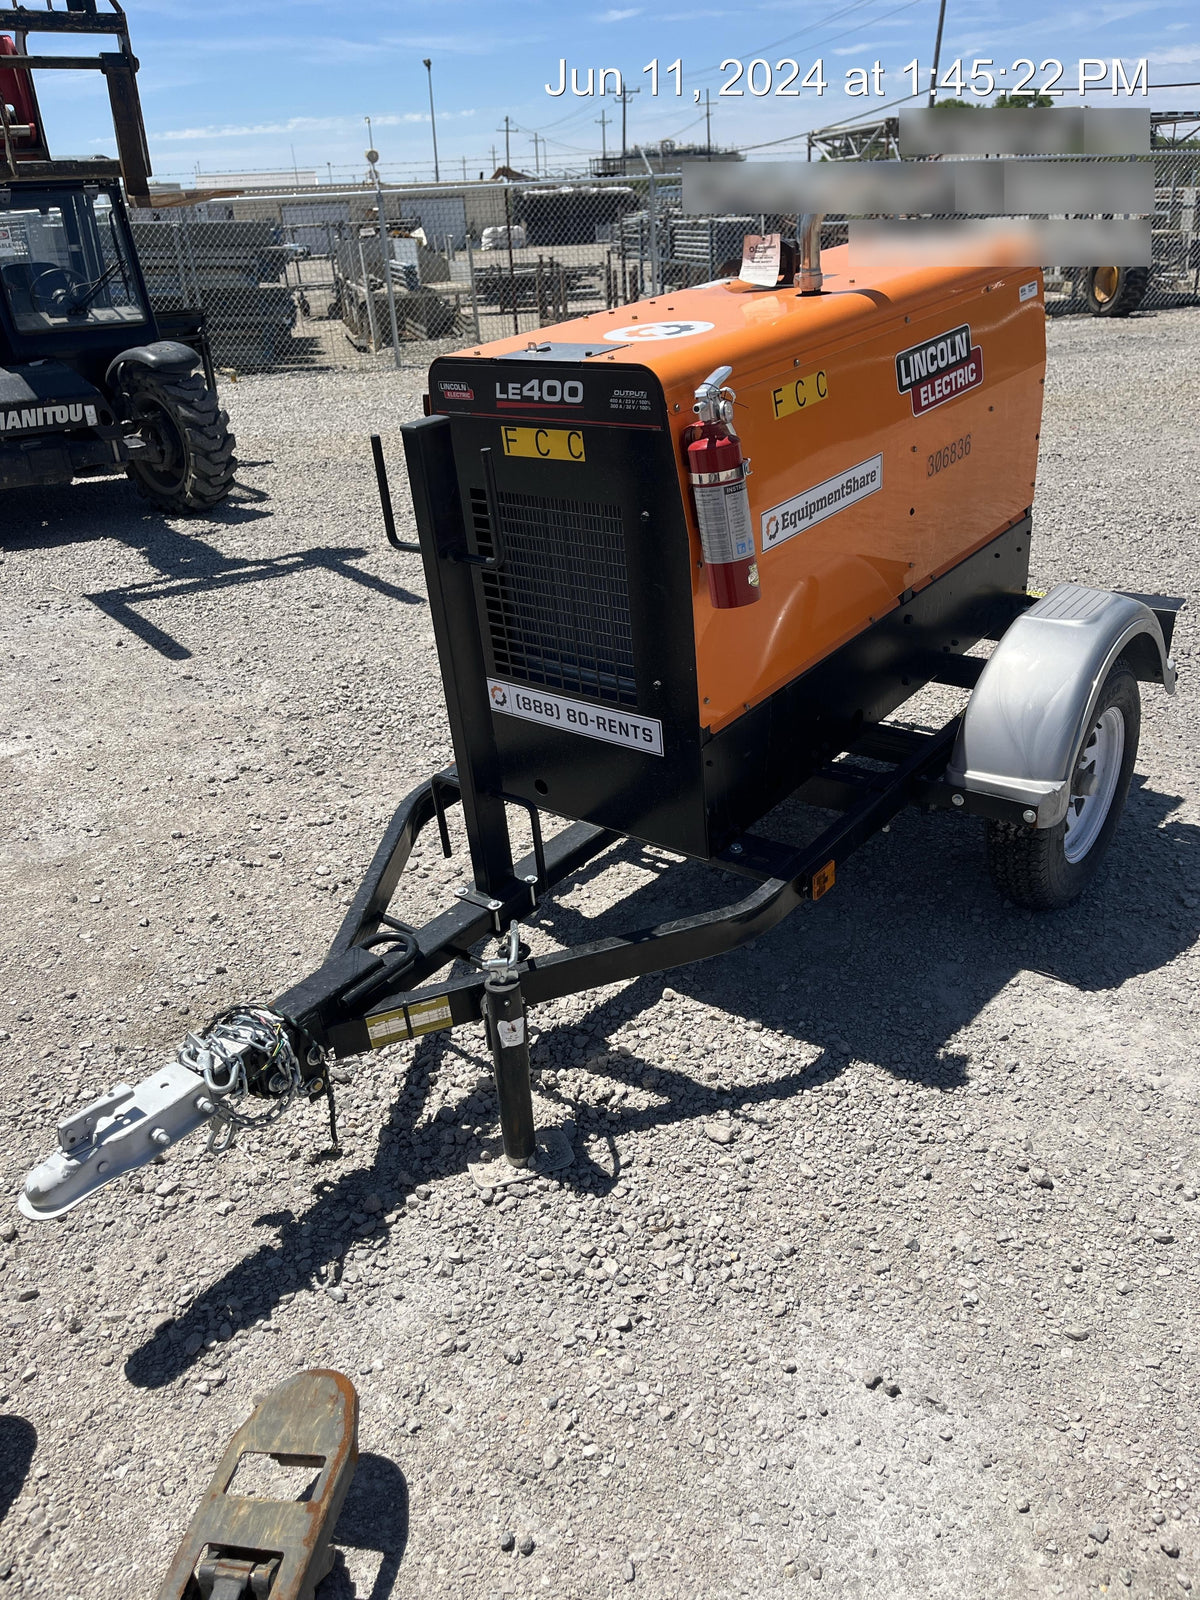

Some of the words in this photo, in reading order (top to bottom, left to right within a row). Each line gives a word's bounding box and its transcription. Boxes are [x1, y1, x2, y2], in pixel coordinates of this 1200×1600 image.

[900, 332, 968, 386] LINCOLN
[439, 382, 467, 391] LINCOLN
[447, 391, 471, 399] ELECTRIC
[496, 379, 584, 404] LE400
[613, 389, 645, 397] OUTPUT
[919, 362, 977, 407] ELECTRIC
[927, 434, 972, 477] 306836
[781, 469, 877, 531] EquipmentShare
[516, 693, 561, 720] (888)
[566, 708, 653, 743] 80-RENTS
